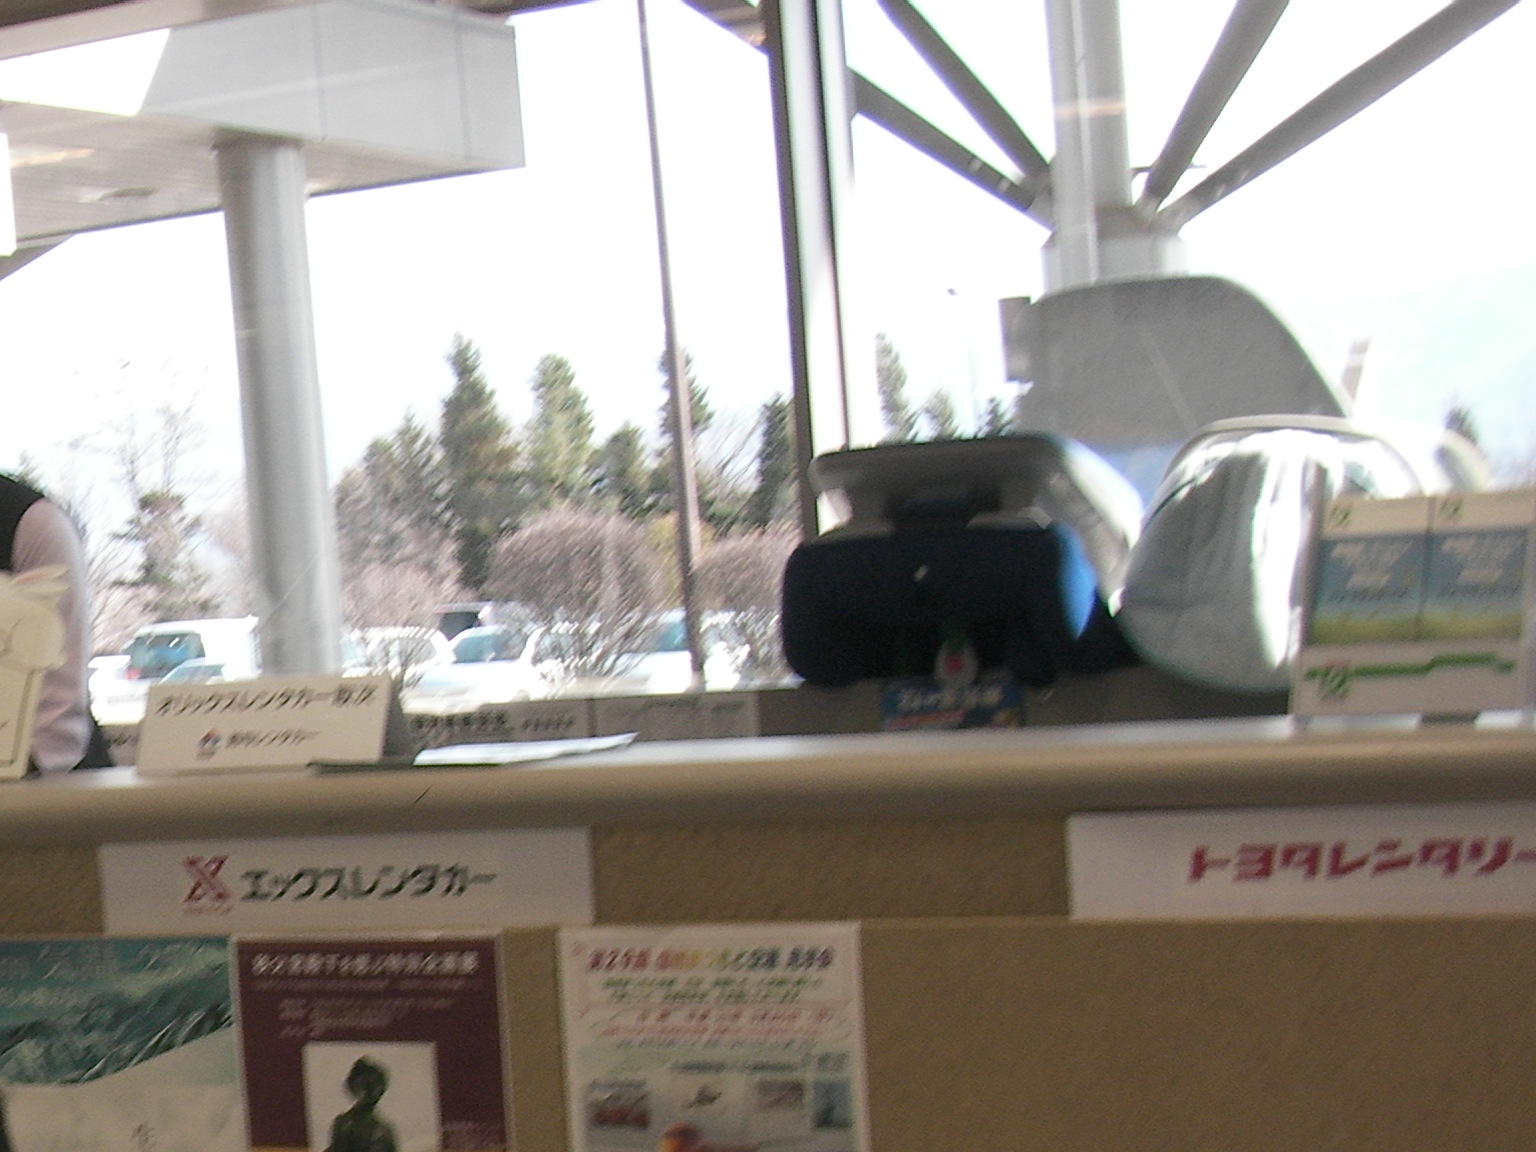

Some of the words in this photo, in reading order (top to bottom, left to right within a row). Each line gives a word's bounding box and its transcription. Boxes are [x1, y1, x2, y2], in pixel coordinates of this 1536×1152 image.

[239, 864, 498, 902] エックスレンタカー
